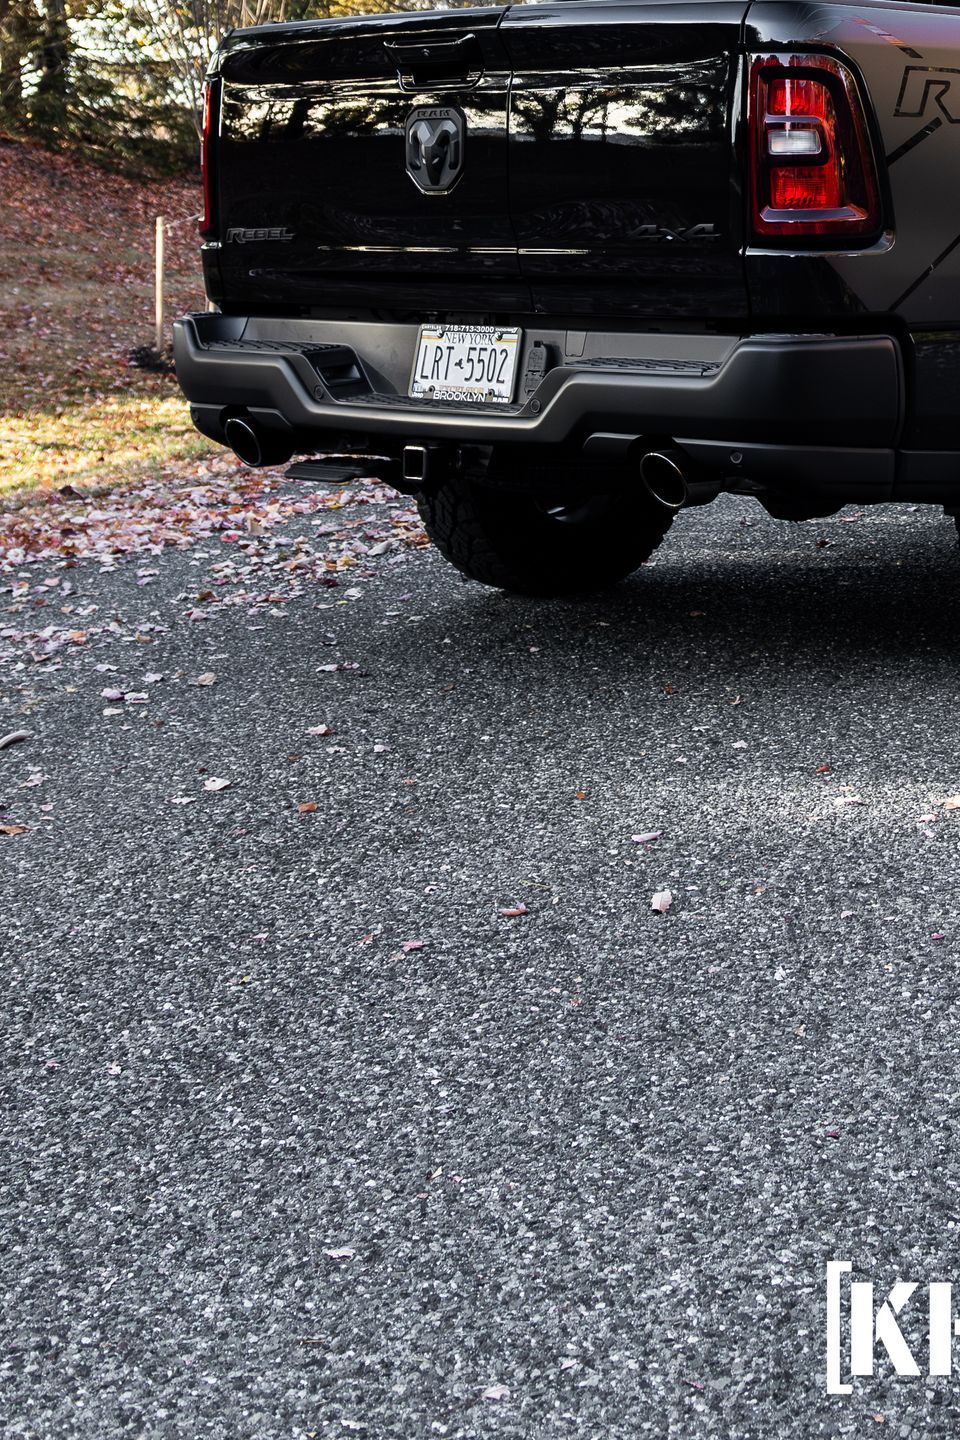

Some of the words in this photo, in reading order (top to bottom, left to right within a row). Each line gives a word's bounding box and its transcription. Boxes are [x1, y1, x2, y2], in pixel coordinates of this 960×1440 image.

[416, 110, 451, 118] RAM
[226, 227, 297, 244] REBEL
[445, 325, 494, 333] 718-713-3000
[444, 332, 466, 344] NEW
[469, 333, 494, 345] YORK
[420, 345, 455, 380] LRT
[464, 347, 508, 383] 5502
[433, 390, 485, 402] BROOKLYN
